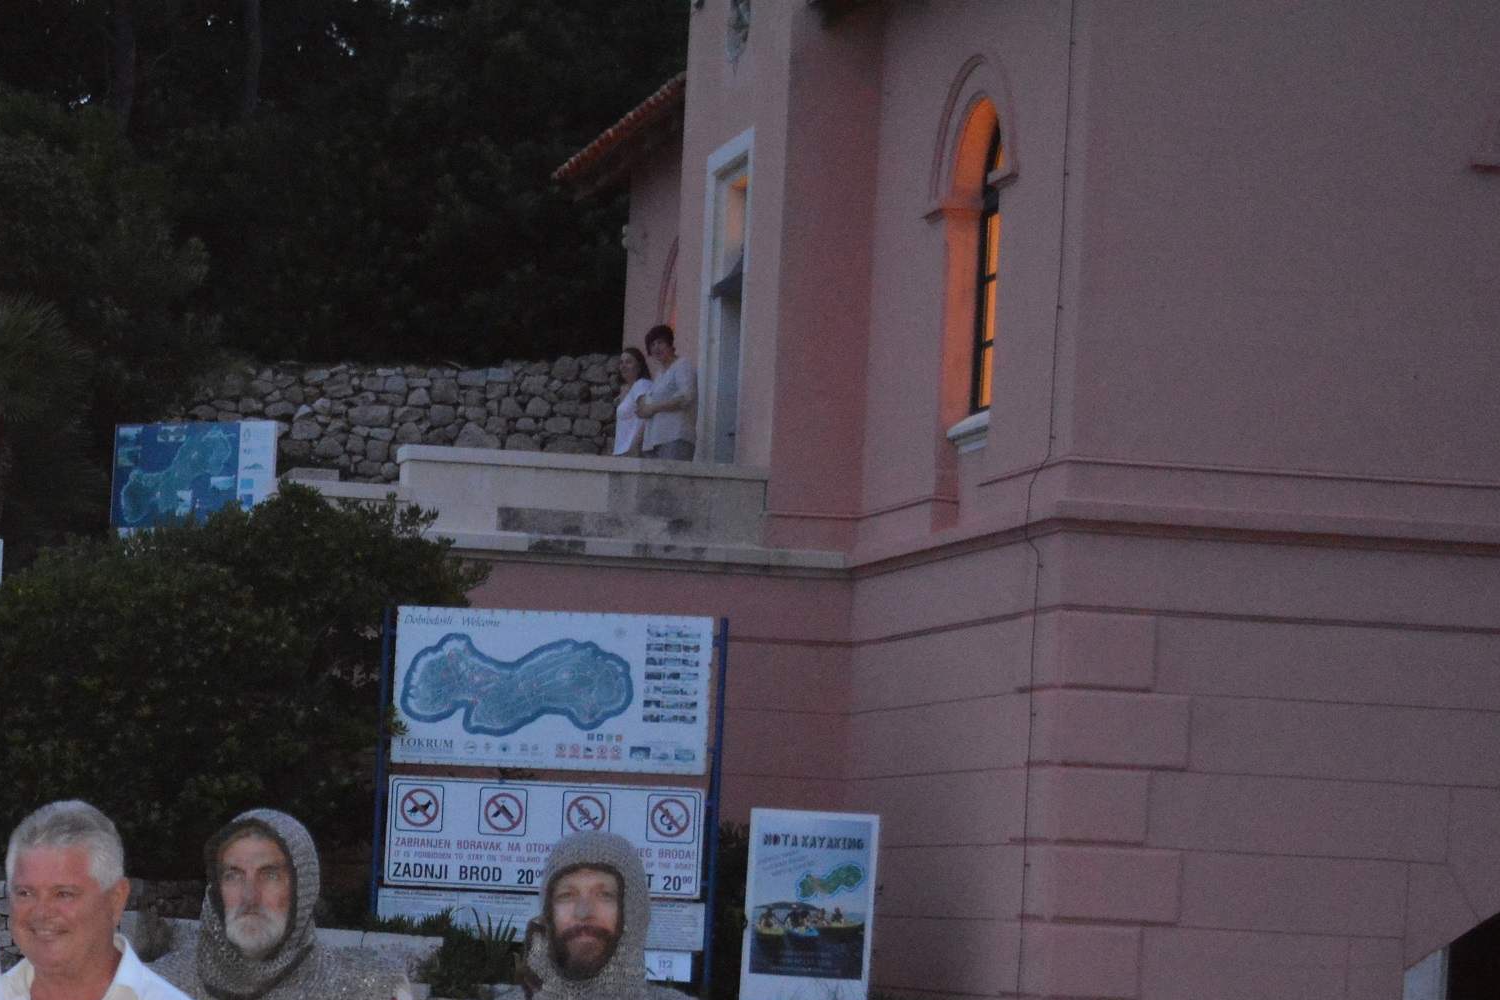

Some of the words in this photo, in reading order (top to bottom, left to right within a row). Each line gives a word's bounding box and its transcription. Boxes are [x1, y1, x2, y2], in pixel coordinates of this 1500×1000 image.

[400, 737, 453, 749] LOKRUM
[394, 836, 451, 849] ZABRANJEN
[456, 838, 501, 852] BORAVAK
[507, 841, 521, 852] NA
[392, 862, 448, 881] ZADNJI
[459, 865, 502, 882] BROD
